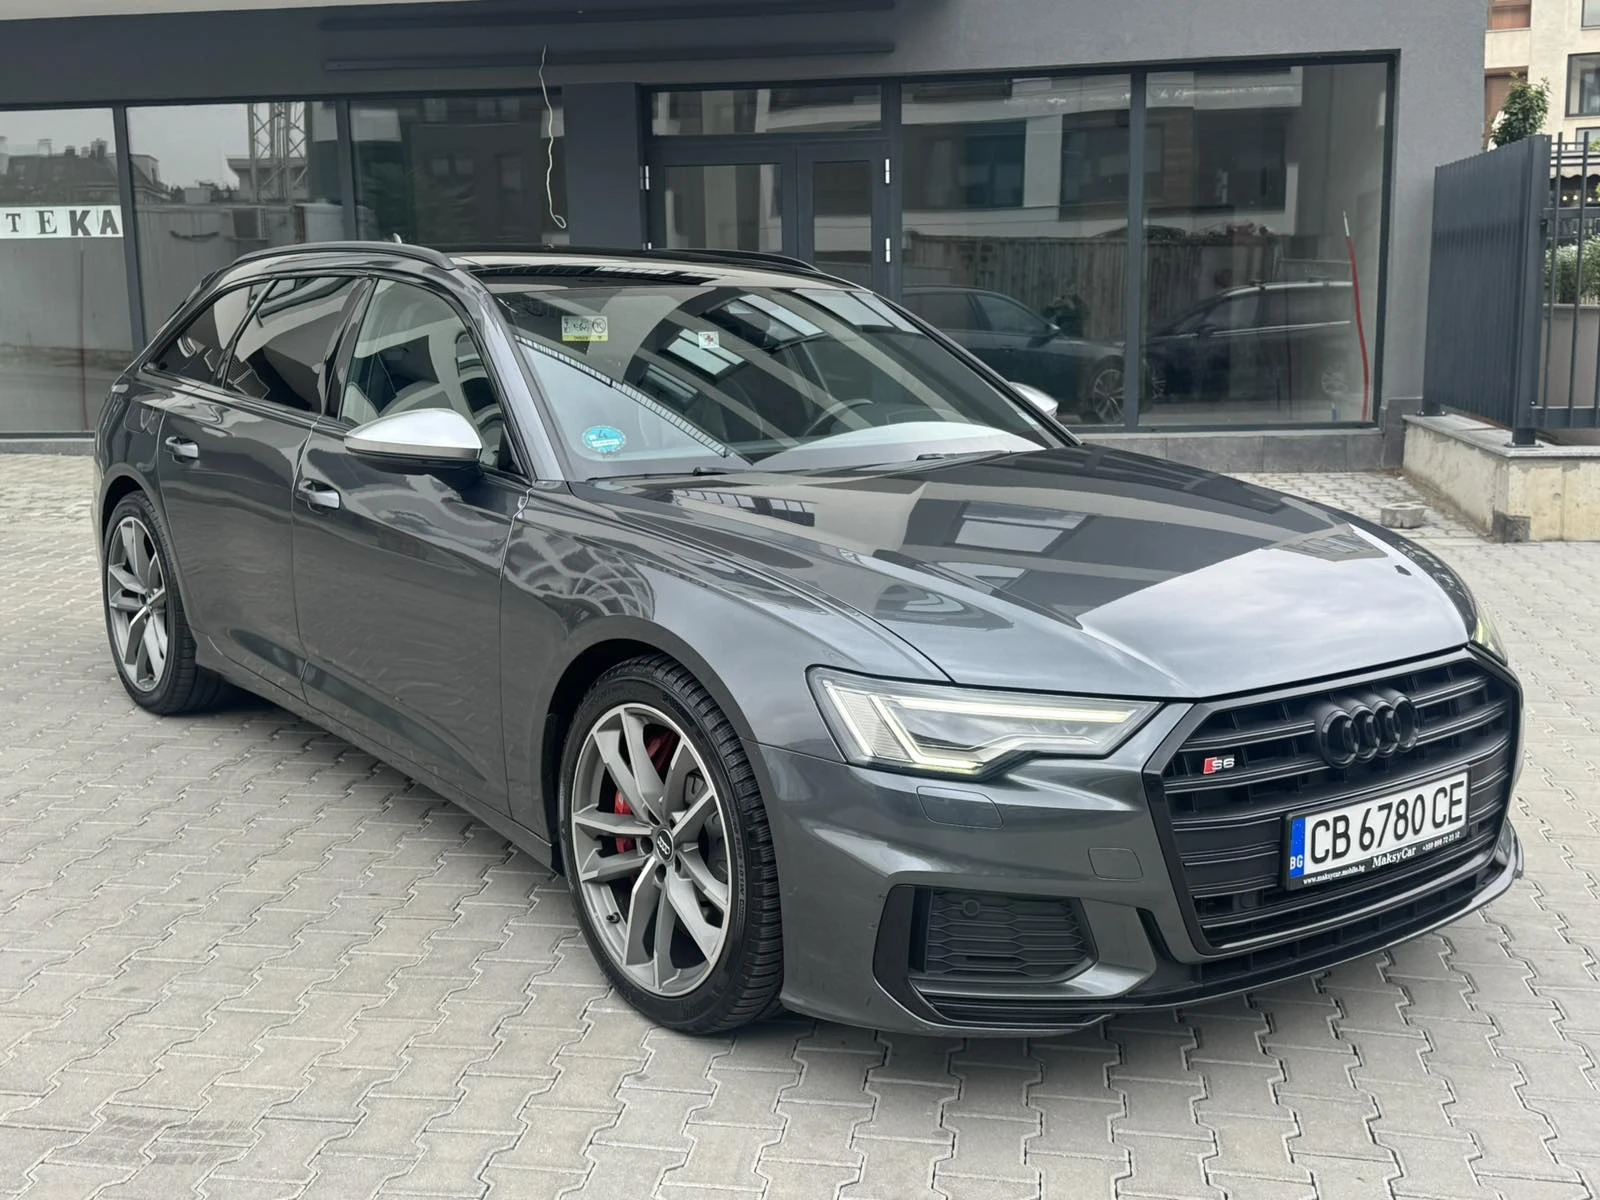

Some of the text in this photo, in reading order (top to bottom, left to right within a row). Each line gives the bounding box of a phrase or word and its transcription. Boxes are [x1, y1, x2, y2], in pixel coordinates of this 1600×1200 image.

[1211, 757, 1235, 770] S6
[1310, 779, 1465, 865] CB 6780 CE
[1289, 854, 1304, 870] BG
[1371, 846, 1417, 868] MaksyCar
